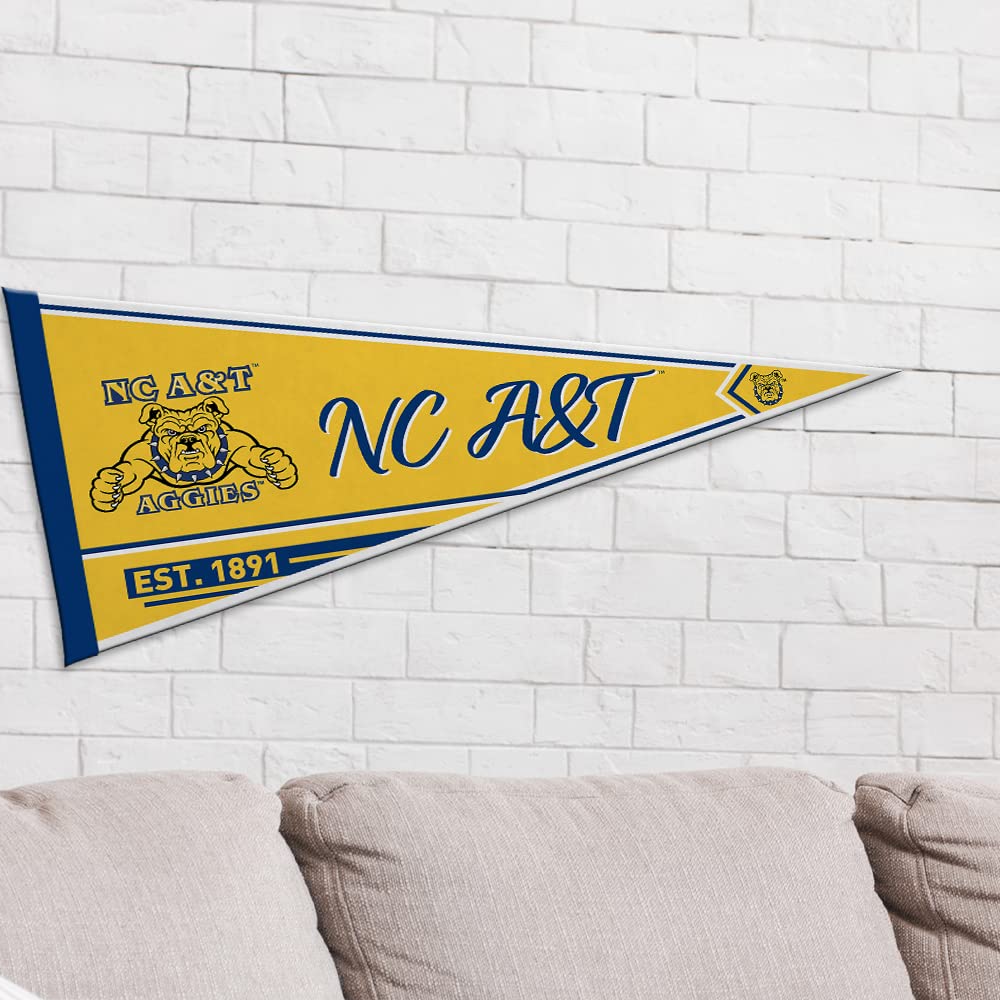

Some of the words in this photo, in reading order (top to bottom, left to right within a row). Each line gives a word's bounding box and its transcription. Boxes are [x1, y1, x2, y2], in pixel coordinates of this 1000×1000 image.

[101, 375, 159, 406] NC
[166, 364, 253, 399] A&T
[319, 389, 451, 478] NC
[467, 368, 657, 460] A&T
[136, 480, 260, 515] AGGIES
[133, 564, 202, 594] EST.
[211, 552, 279, 583] 1891
